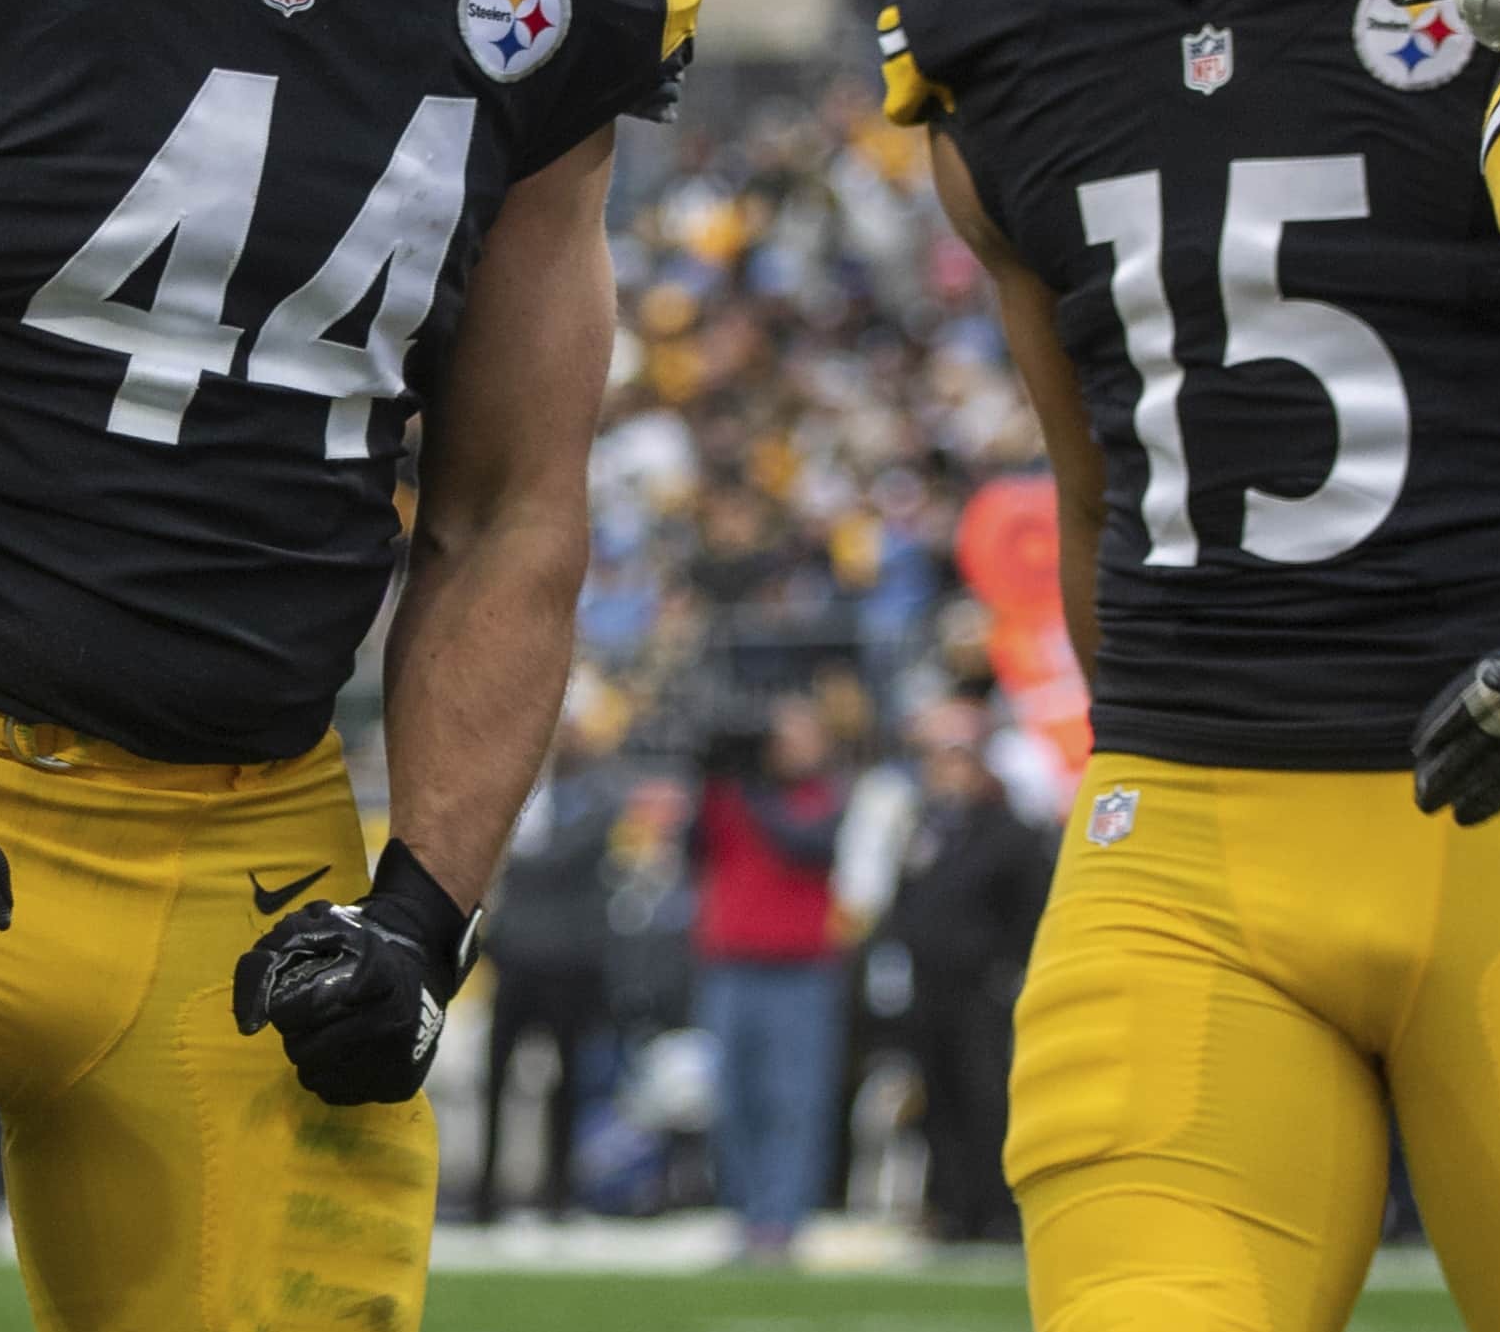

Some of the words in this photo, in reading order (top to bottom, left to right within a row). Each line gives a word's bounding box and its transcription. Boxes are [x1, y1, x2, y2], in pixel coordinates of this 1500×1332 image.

[468, 2, 512, 23] Steelers
[21, 67, 477, 460] 44
[1077, 153, 1412, 567] 15
